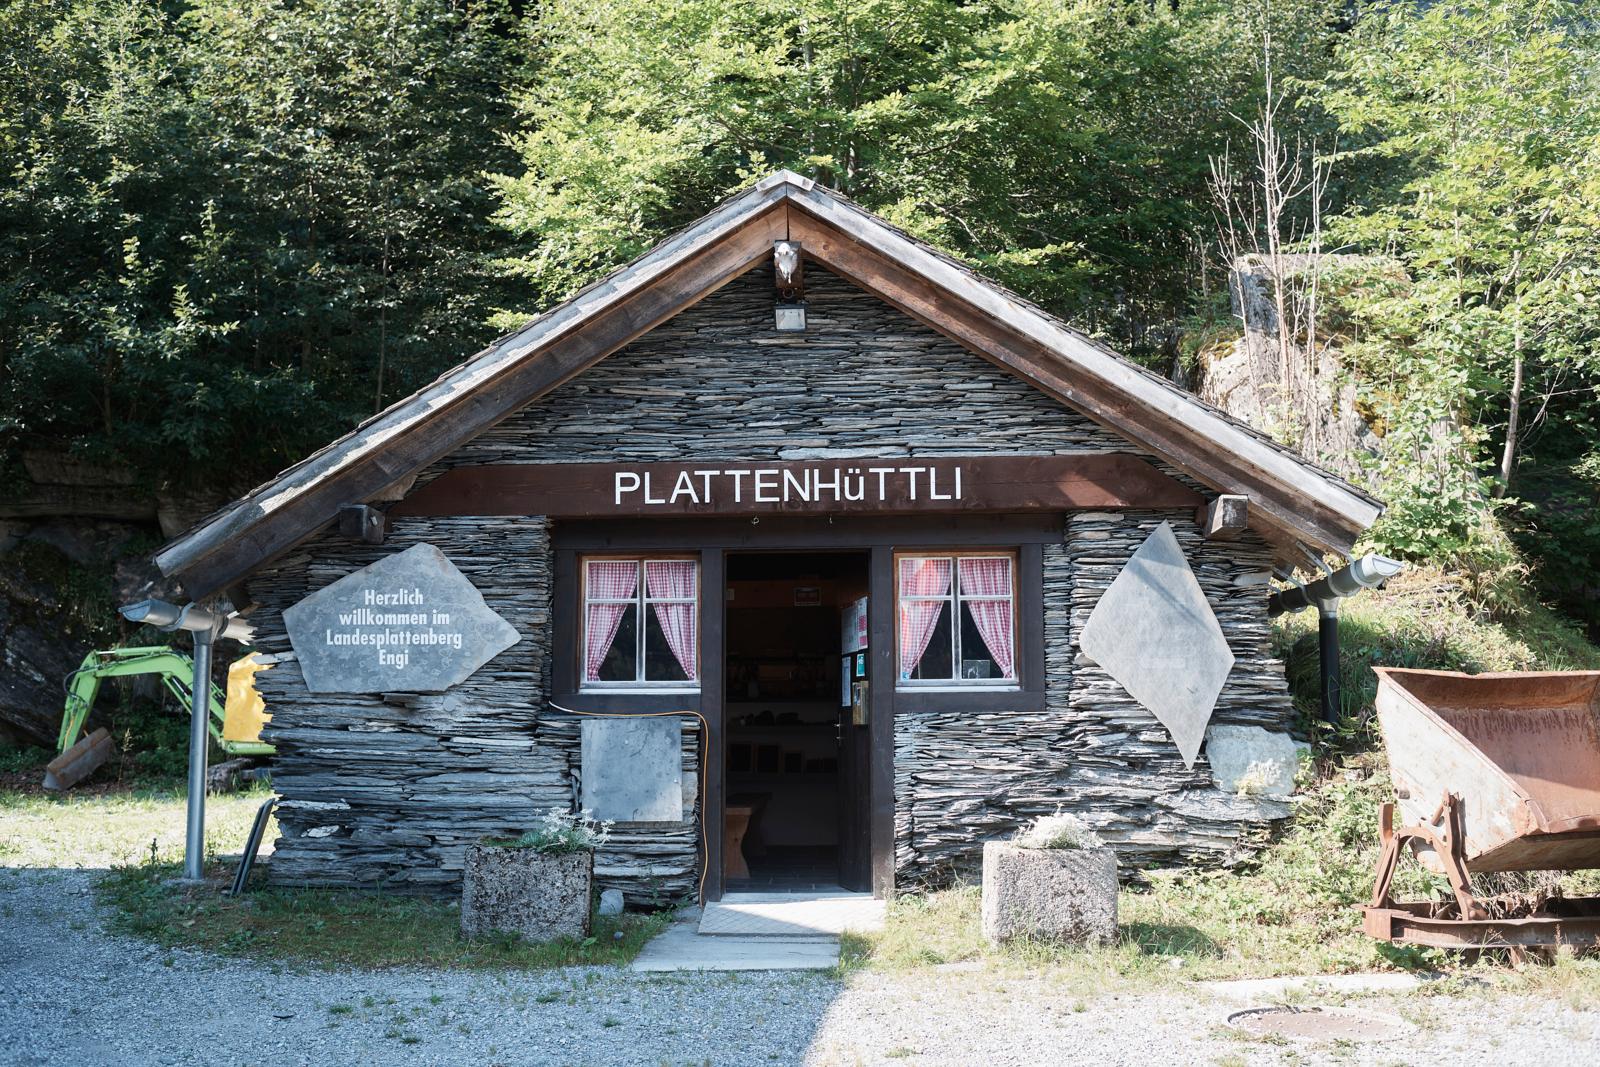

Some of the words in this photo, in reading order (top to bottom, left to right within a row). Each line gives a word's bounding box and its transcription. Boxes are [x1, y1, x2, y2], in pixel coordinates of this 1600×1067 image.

[614, 466, 962, 505] PLATTENHüTTLI
[364, 588, 424, 606] Herzlich
[339, 608, 427, 626] willkommen
[432, 609, 450, 625] im
[326, 628, 462, 649] Landesplattenberg
[378, 650, 409, 670] Engi
